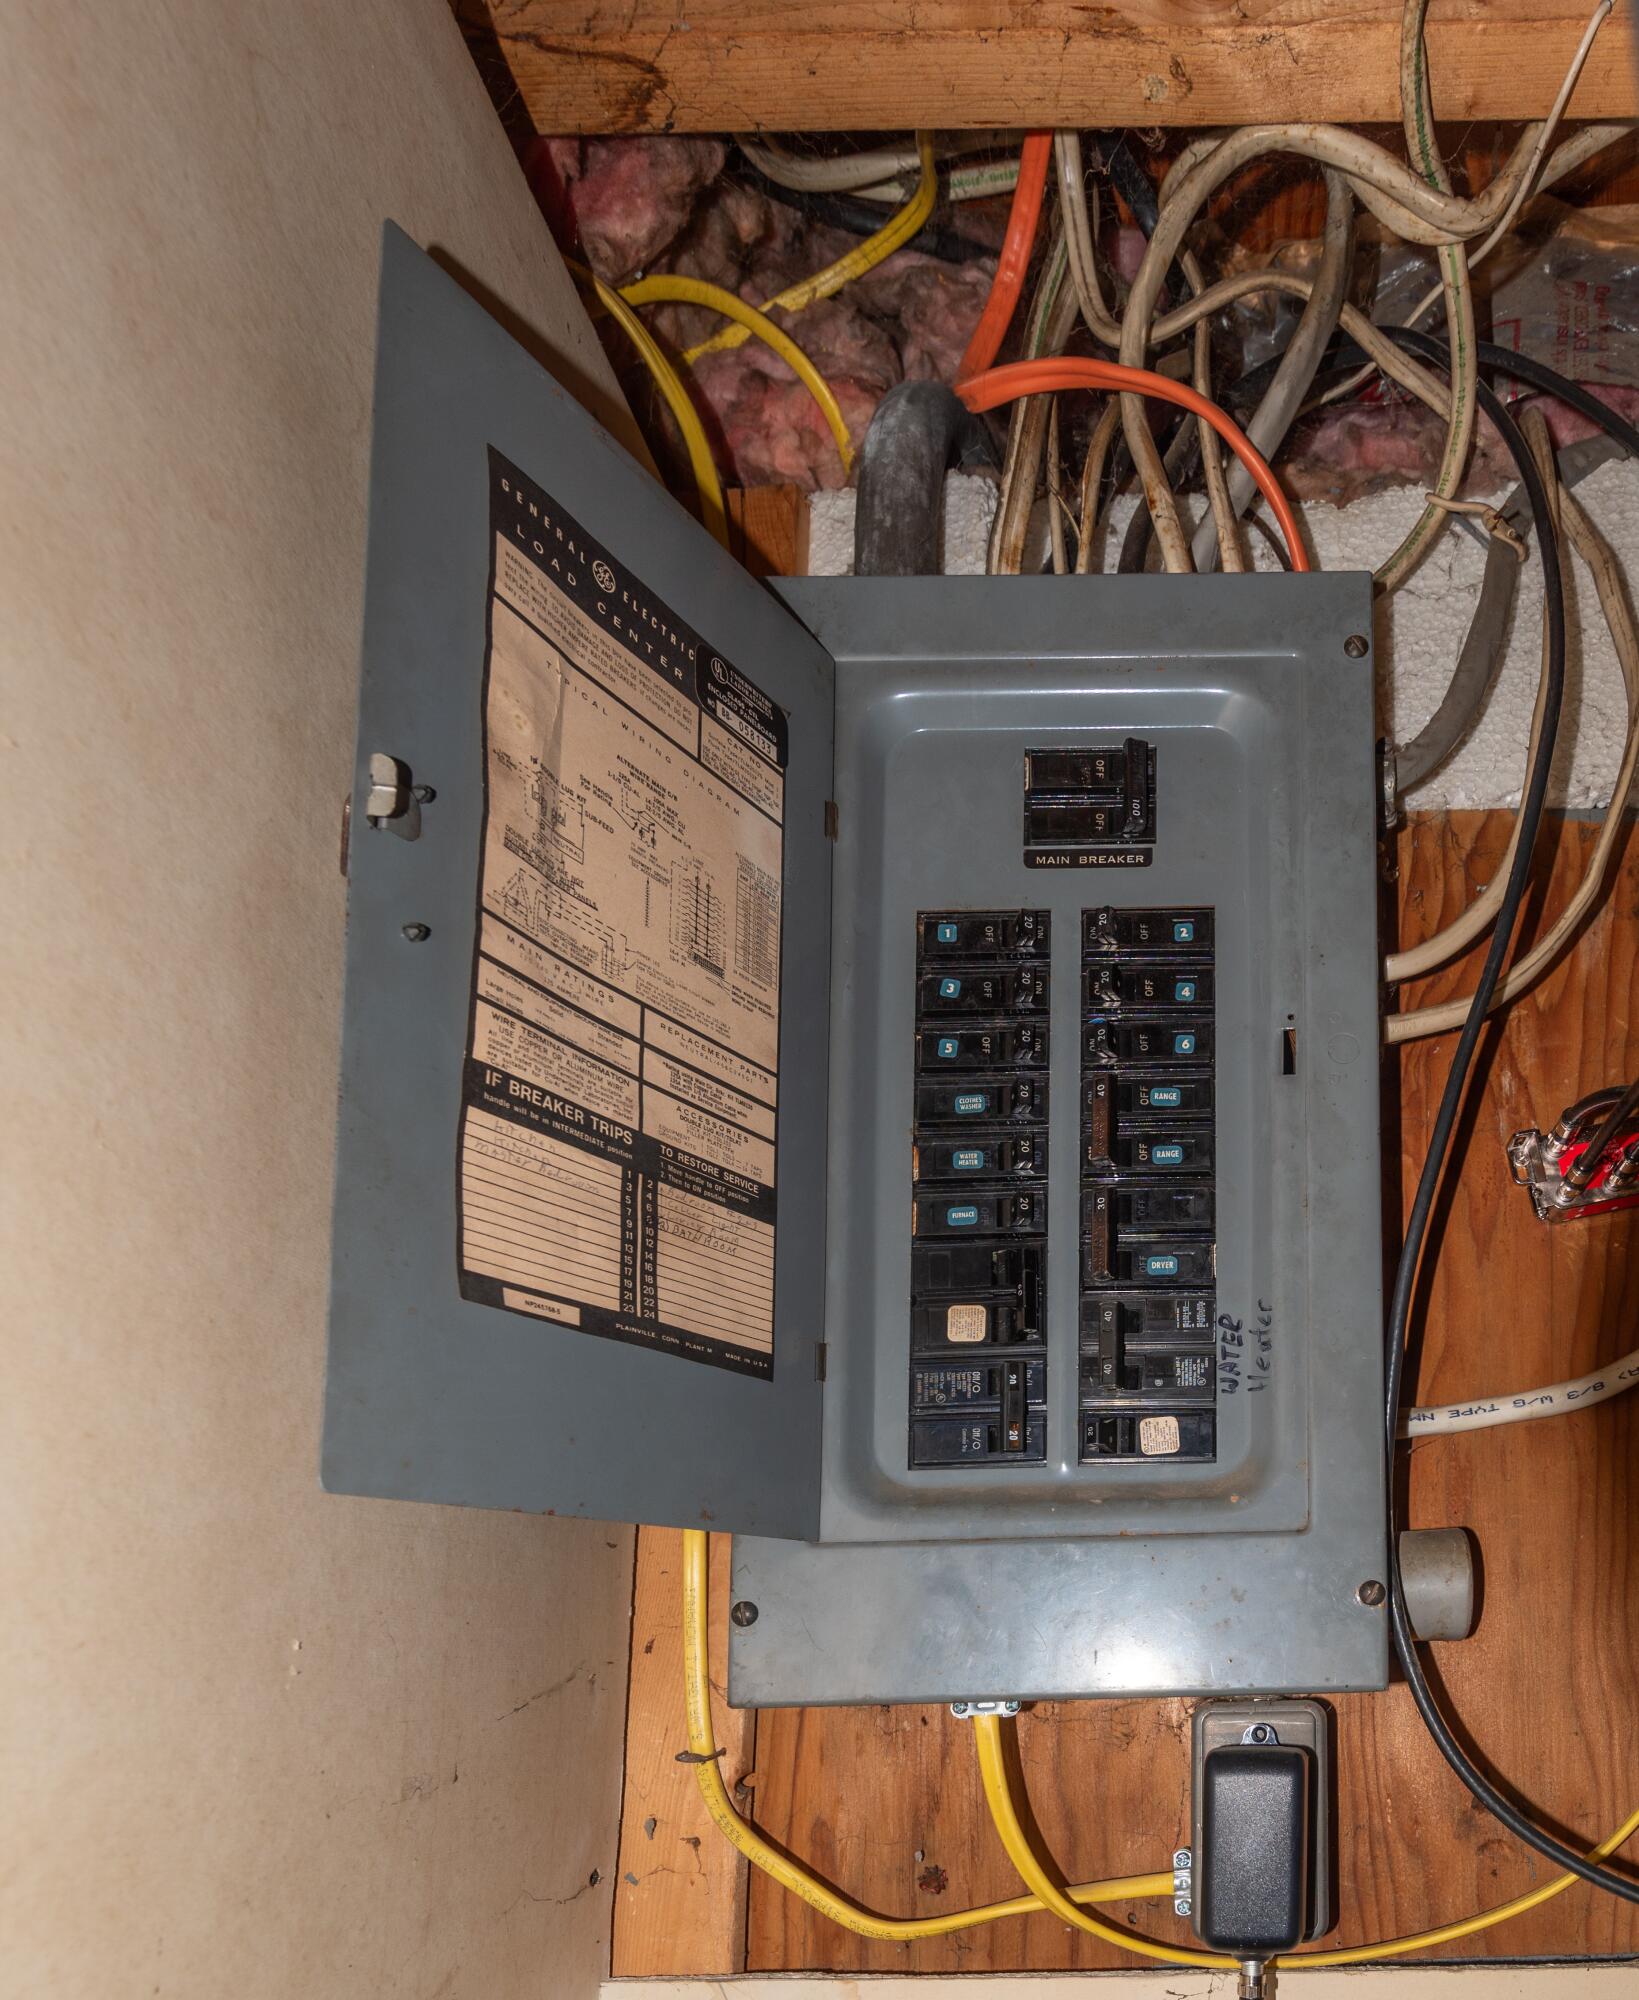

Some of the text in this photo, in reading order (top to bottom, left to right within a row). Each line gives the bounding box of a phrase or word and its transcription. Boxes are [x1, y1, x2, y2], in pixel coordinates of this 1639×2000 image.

[501, 478, 695, 661] GENERAL ELECTRIC
[517, 524, 683, 680] LOAD CENTER
[620, 719, 672, 767] WIRING
[682, 766, 741, 819] DIAGRAM
[1096, 759, 1105, 779] OFF
[1096, 813, 1105, 831] OFF
[1036, 855, 1144, 864] MAIN BREAKER
[1024, 916, 1033, 929] 20
[1099, 913, 1107, 926] 20
[945, 929, 950, 938] 1
[985, 926, 994, 943] OFF
[1140, 923, 1149, 940] OFF
[1180, 928, 1188, 937] 2
[505, 932, 543, 962] MAIN
[553, 961, 615, 1005] RATINGS
[1022, 972, 1031, 985] 20
[1101, 971, 1109, 984] 20
[946, 983, 954, 993] 3
[983, 981, 992, 999] OFF
[1145, 979, 1154, 997] OFF
[1181, 987, 1190, 997] 4
[498, 1025, 514, 1039] USE
[1022, 1030, 1031, 1042] 20
[1098, 1028, 1106, 1041] 20
[945, 1043, 952, 1053] 5
[982, 1037, 991, 1054] OFF
[1140, 1034, 1149, 1051] OFF
[1182, 1040, 1190, 1049] 6
[491, 1011, 516, 1030] WIRE
[520, 1025, 567, 1056] TERMINAL
[571, 1052, 630, 1087] INFORMATION
[659, 1018, 733, 1068] REPLACEMENT
[739, 1062, 768, 1085] PARTS
[1020, 1085, 1029, 1098] 20
[1097, 1084, 1105, 1097] 40
[1140, 1085, 1149, 1105] OFF
[1154, 1092, 1177, 1100] RANGE
[484, 1068, 633, 1146] IF BREAKER TRIPS
[483, 1091, 632, 1161] handle will be in INTERMEDIATE position
[675, 1102, 749, 1145] ACCESSORIES
[1020, 1140, 1030, 1153] 20
[1139, 1143, 1148, 1161] OFF
[1157, 1150, 1179, 1158] RANGE
[660, 1144, 759, 1194] TO RESTORE SERVICE
[627, 1171, 632, 1179] 1
[626, 1183, 632, 1191] 3
[647, 1180, 653, 1188] 2
[667, 1165, 749, 1204] Move handle to OFF position
[668, 1175, 682, 1186] Then
[703, 1189, 726, 1204] position
[625, 1195, 632, 1204] 5
[647, 1193, 652, 1201] 4
[646, 1204, 652, 1212] 6
[1020, 1198, 1029, 1210] 20
[1097, 1197, 1105, 1210] 30
[626, 1207, 632, 1216] 7
[952, 1211, 975, 1219] FURNACE
[626, 1220, 632, 1228] 9
[626, 1232, 633, 1240] 11
[645, 1227, 654, 1236] 10
[625, 1244, 633, 1253] 13
[645, 1239, 653, 1247] 12
[624, 1256, 632, 1265] 15
[645, 1252, 653, 1260] 14
[645, 1262, 653, 1271] 16
[1152, 1261, 1174, 1269] DRYER
[624, 1267, 632, 1276] 17
[624, 1279, 632, 1288] 19
[645, 1275, 653, 1284] 18
[624, 1292, 633, 1300] 21
[643, 1286, 654, 1295] 20
[643, 1298, 655, 1307] 22
[623, 1304, 634, 1313] 23
[643, 1310, 655, 1319] 24
[1104, 1310, 1113, 1321] 40
[1218, 1313, 1244, 1394] WATER
[1103, 1364, 1112, 1375] 40
[1409, 1381, 1606, 1422] 8/3 W/G TYPE NM
[1009, 1430, 1018, 1440] 20
[1087, 1426, 1093, 1436] 20
